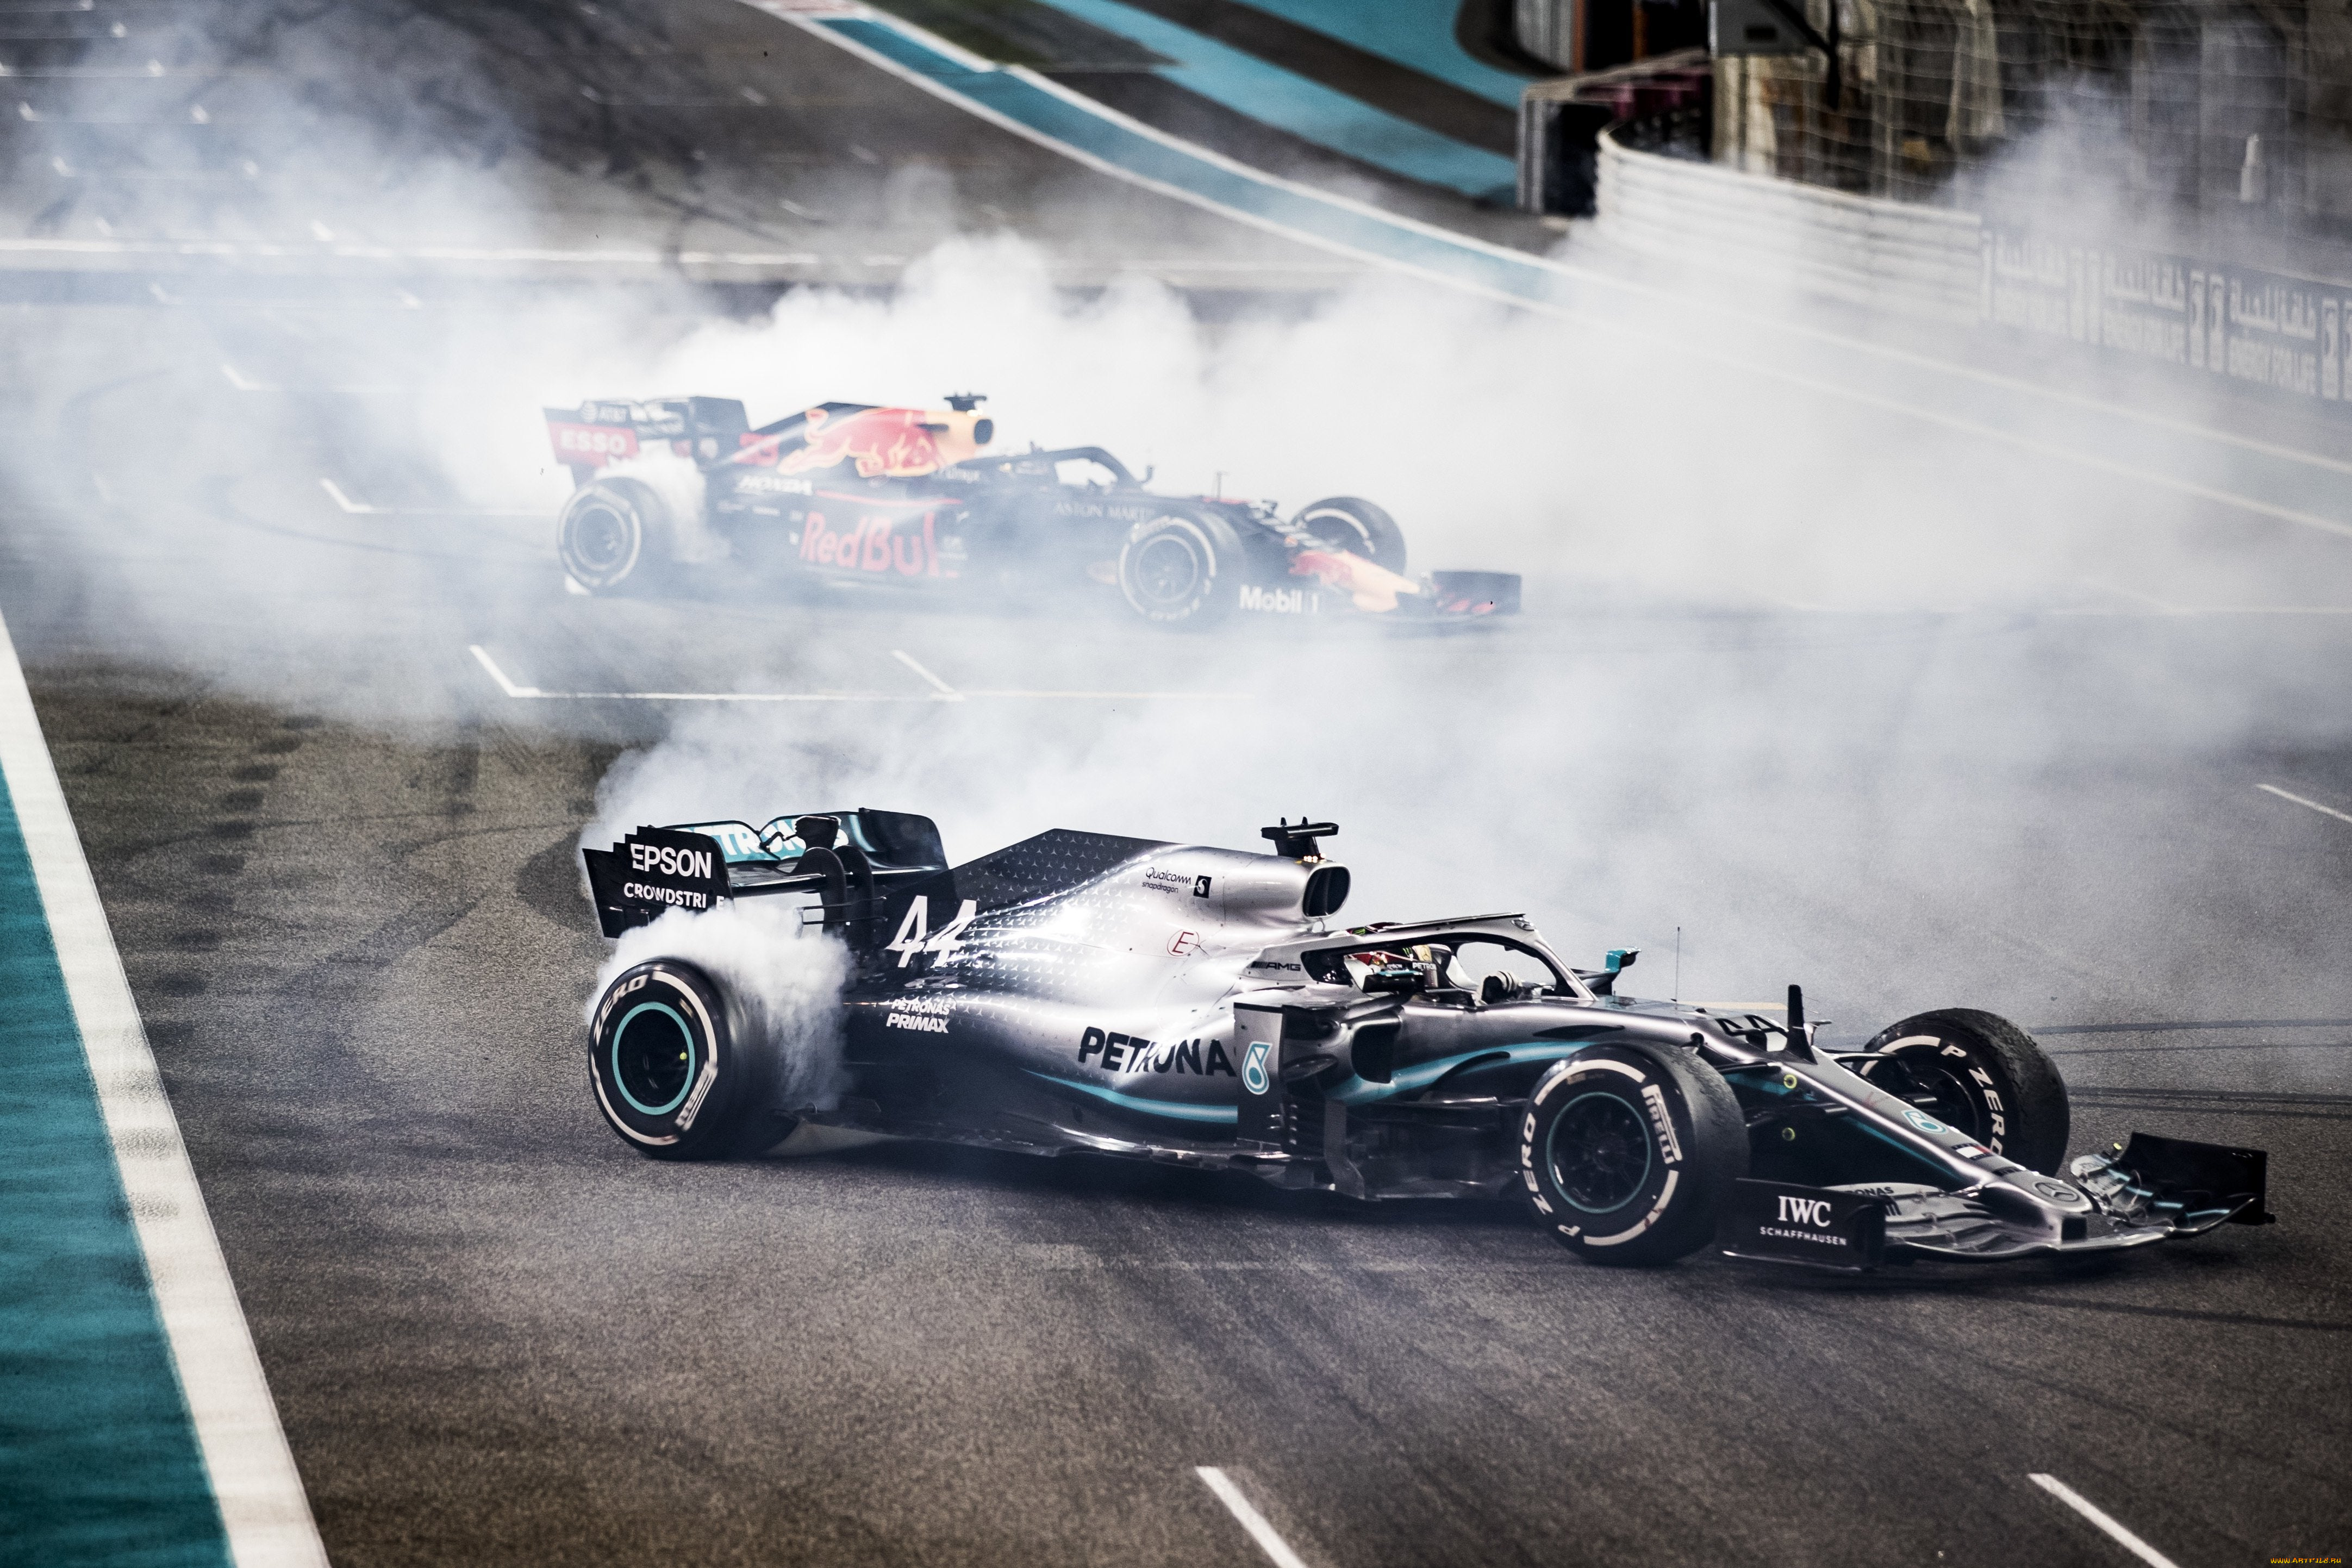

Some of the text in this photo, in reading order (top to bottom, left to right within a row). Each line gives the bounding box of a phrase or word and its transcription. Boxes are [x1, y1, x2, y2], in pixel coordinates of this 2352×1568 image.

[1240, 584, 1303, 614] Mobil
[630, 843, 712, 879] EPSON
[1141, 882, 1179, 894] snapdragon
[1145, 867, 1191, 884] Qualcomm
[623, 882, 725, 910] CROWDSTRIE
[884, 895, 977, 968] 44
[1171, 930, 1195, 954] E
[1265, 961, 1301, 972] AMG
[891, 998, 951, 1015] PETRONAS
[886, 1013, 950, 1034] PRIMAX
[1078, 1026, 1237, 1078] PETRONA
[1940, 1045, 1967, 1058] P
[1640, 1084, 1683, 1165] PIRELLI
[1521, 1112, 1554, 1215] ZERO
[1778, 1195, 1831, 1227] IWC
[1760, 1226, 1848, 1246] SCHAFFHAUSEN
